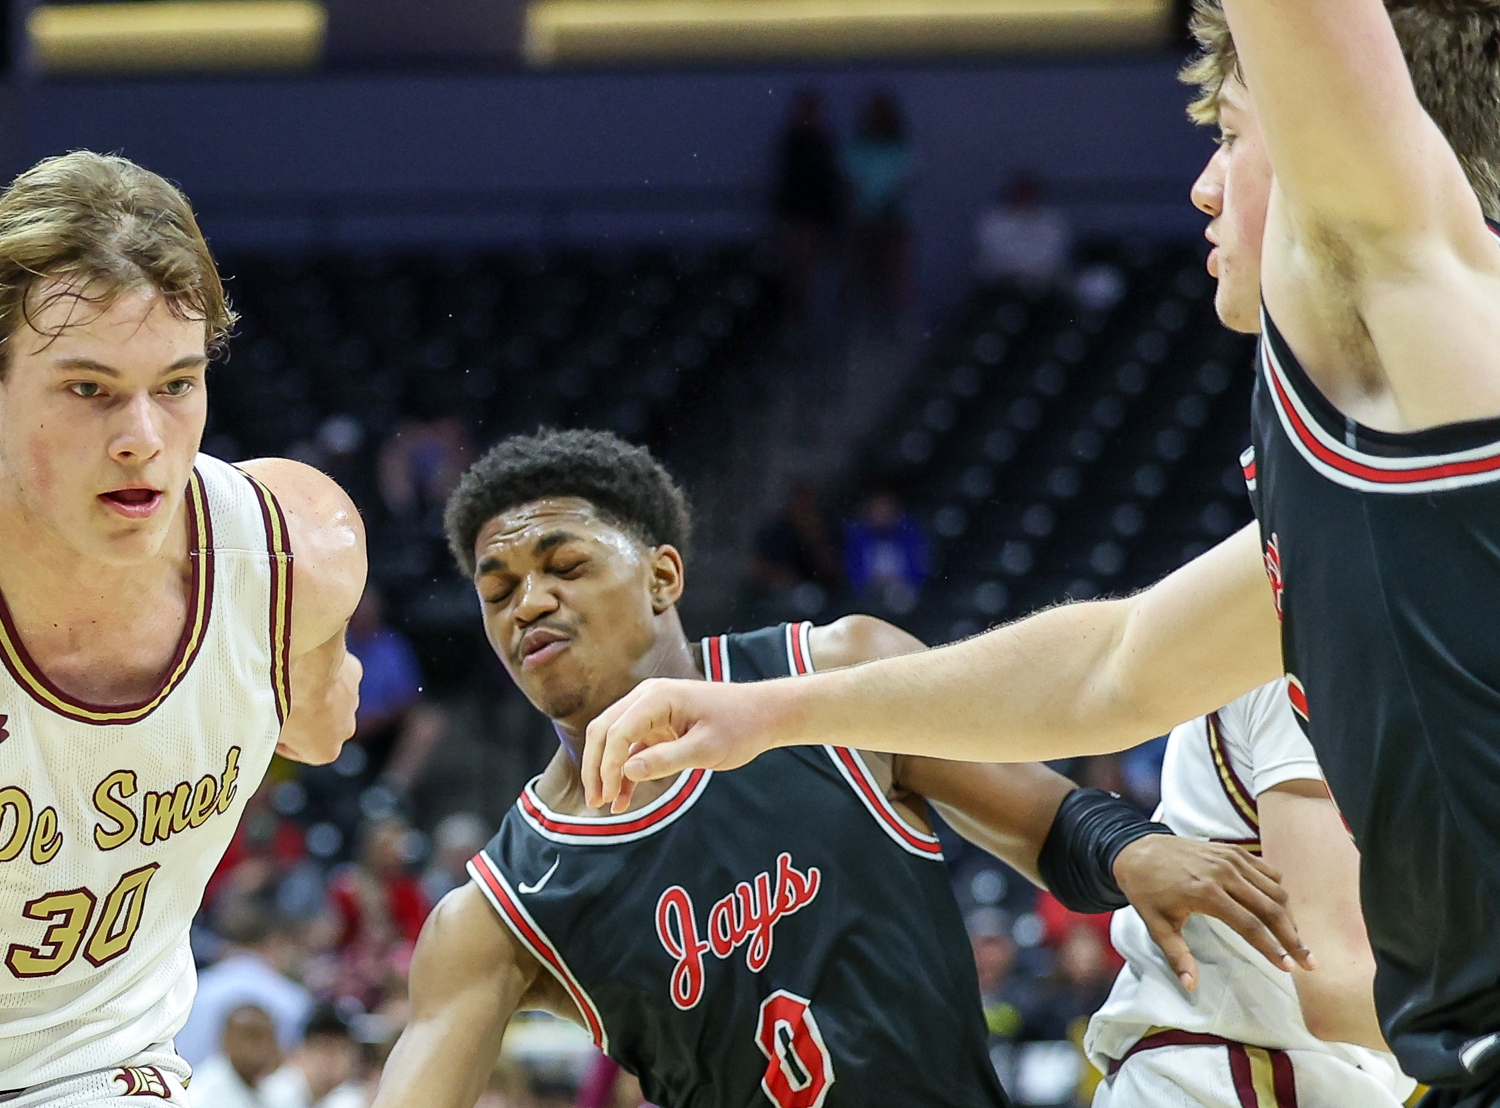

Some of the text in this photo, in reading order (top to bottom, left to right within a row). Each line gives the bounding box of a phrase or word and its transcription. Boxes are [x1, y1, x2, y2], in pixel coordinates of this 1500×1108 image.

[93, 745, 241, 851] Smet
[5, 862, 160, 978] 30
[655, 852, 821, 1011] Jays
